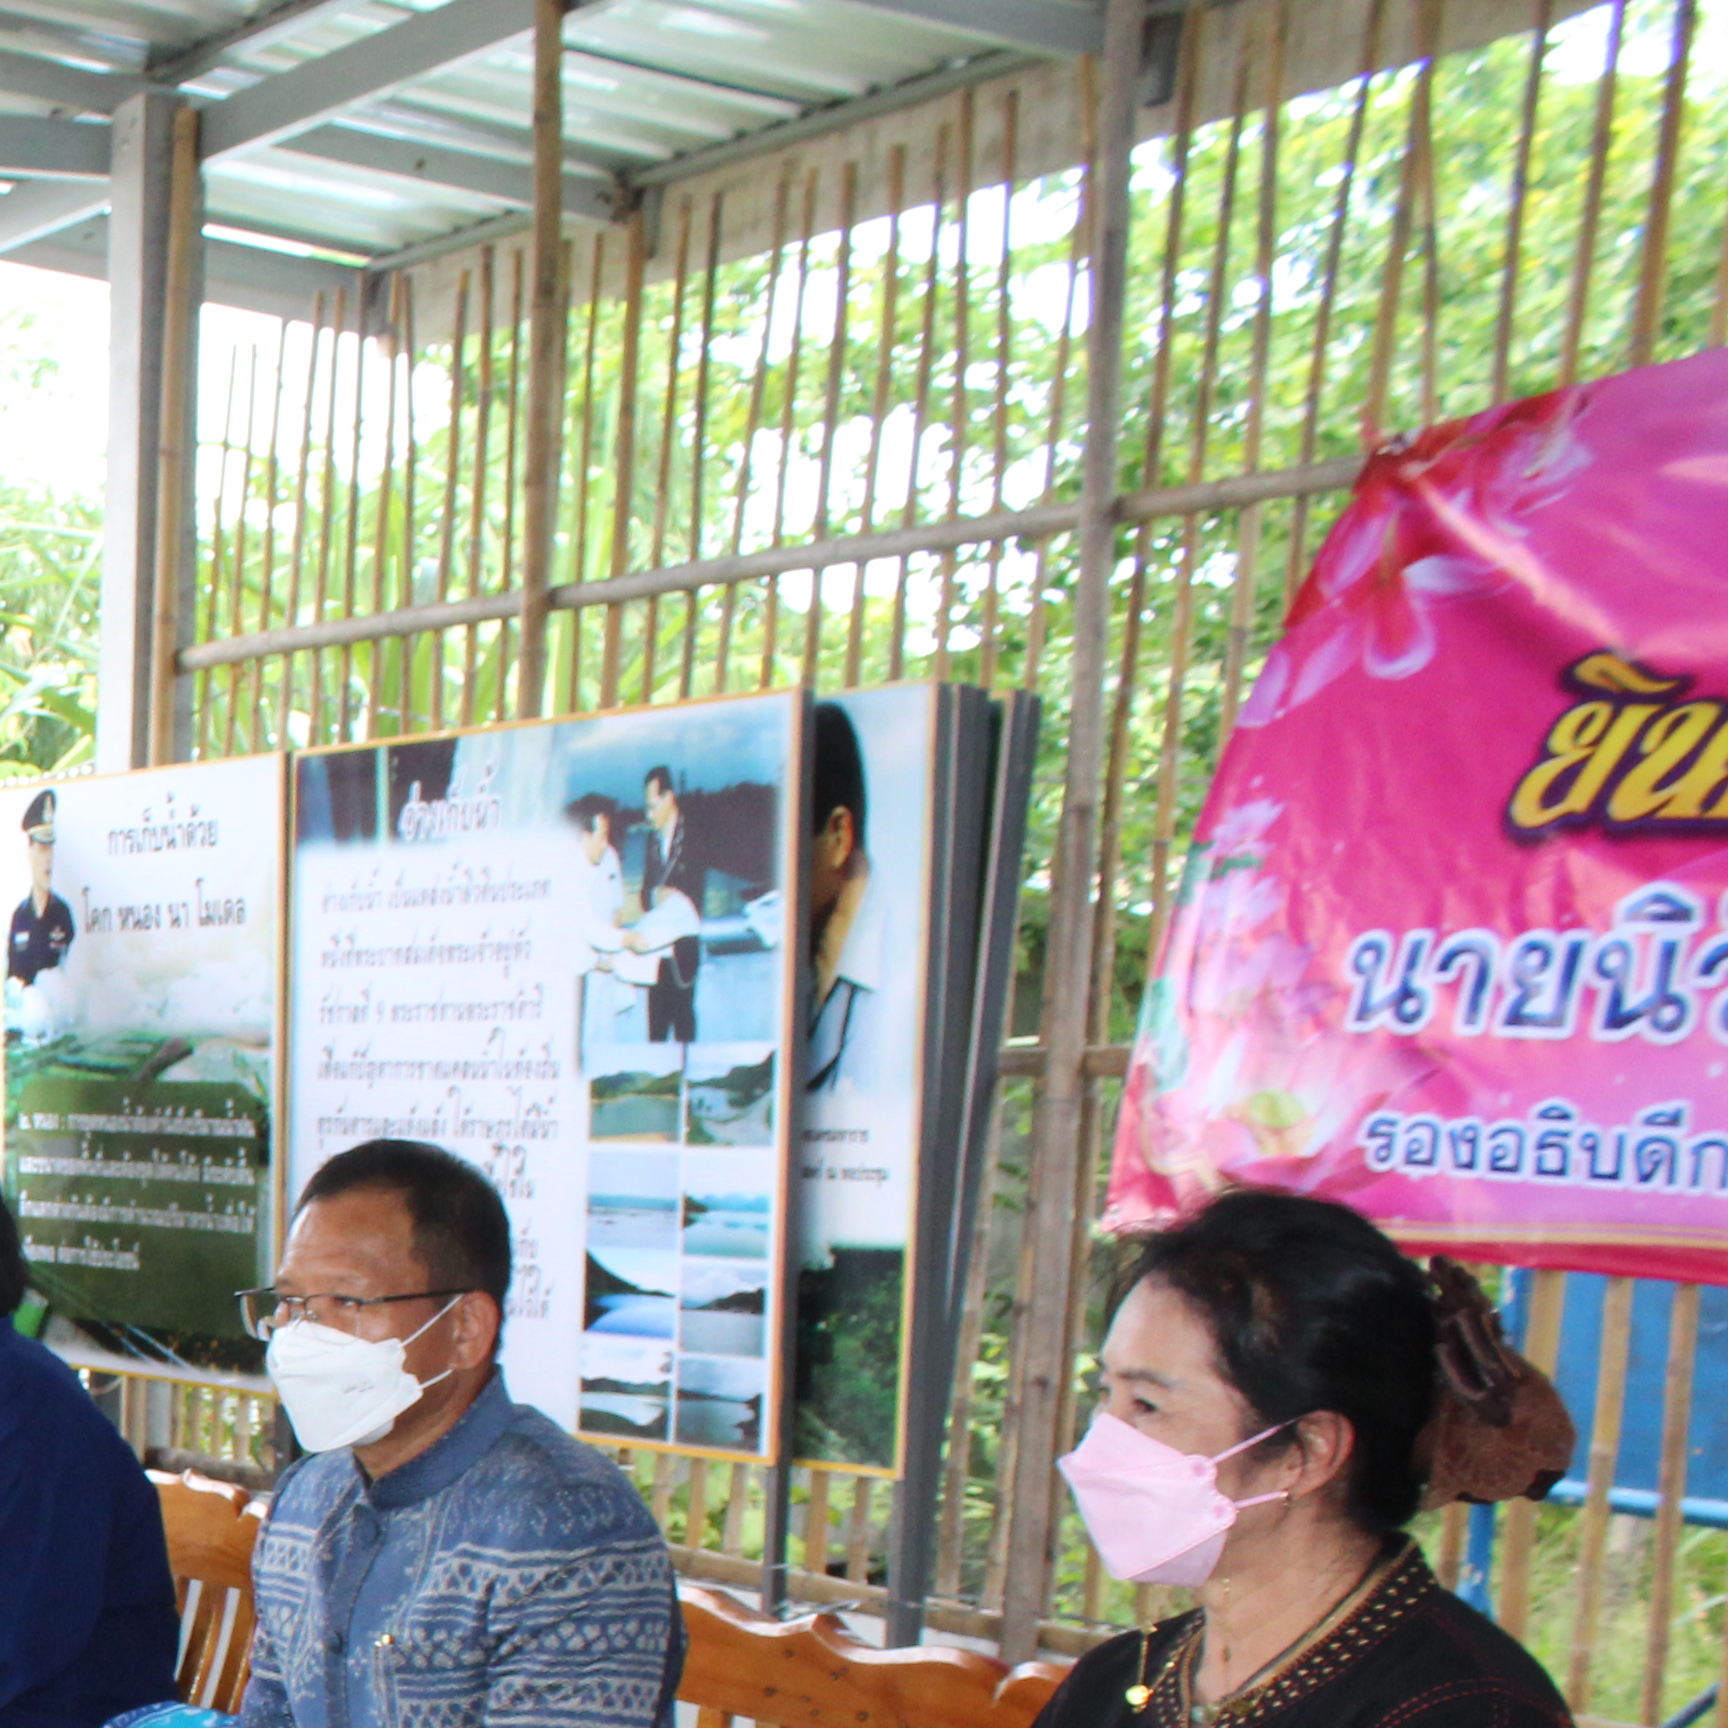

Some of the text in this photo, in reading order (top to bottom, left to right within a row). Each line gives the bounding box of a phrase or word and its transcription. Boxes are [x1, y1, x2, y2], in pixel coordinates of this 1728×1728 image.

[108, 792, 218, 855] การเก็บน้ำด้วย
[81, 877, 246, 934] โคก หนอง นา โมเดล
